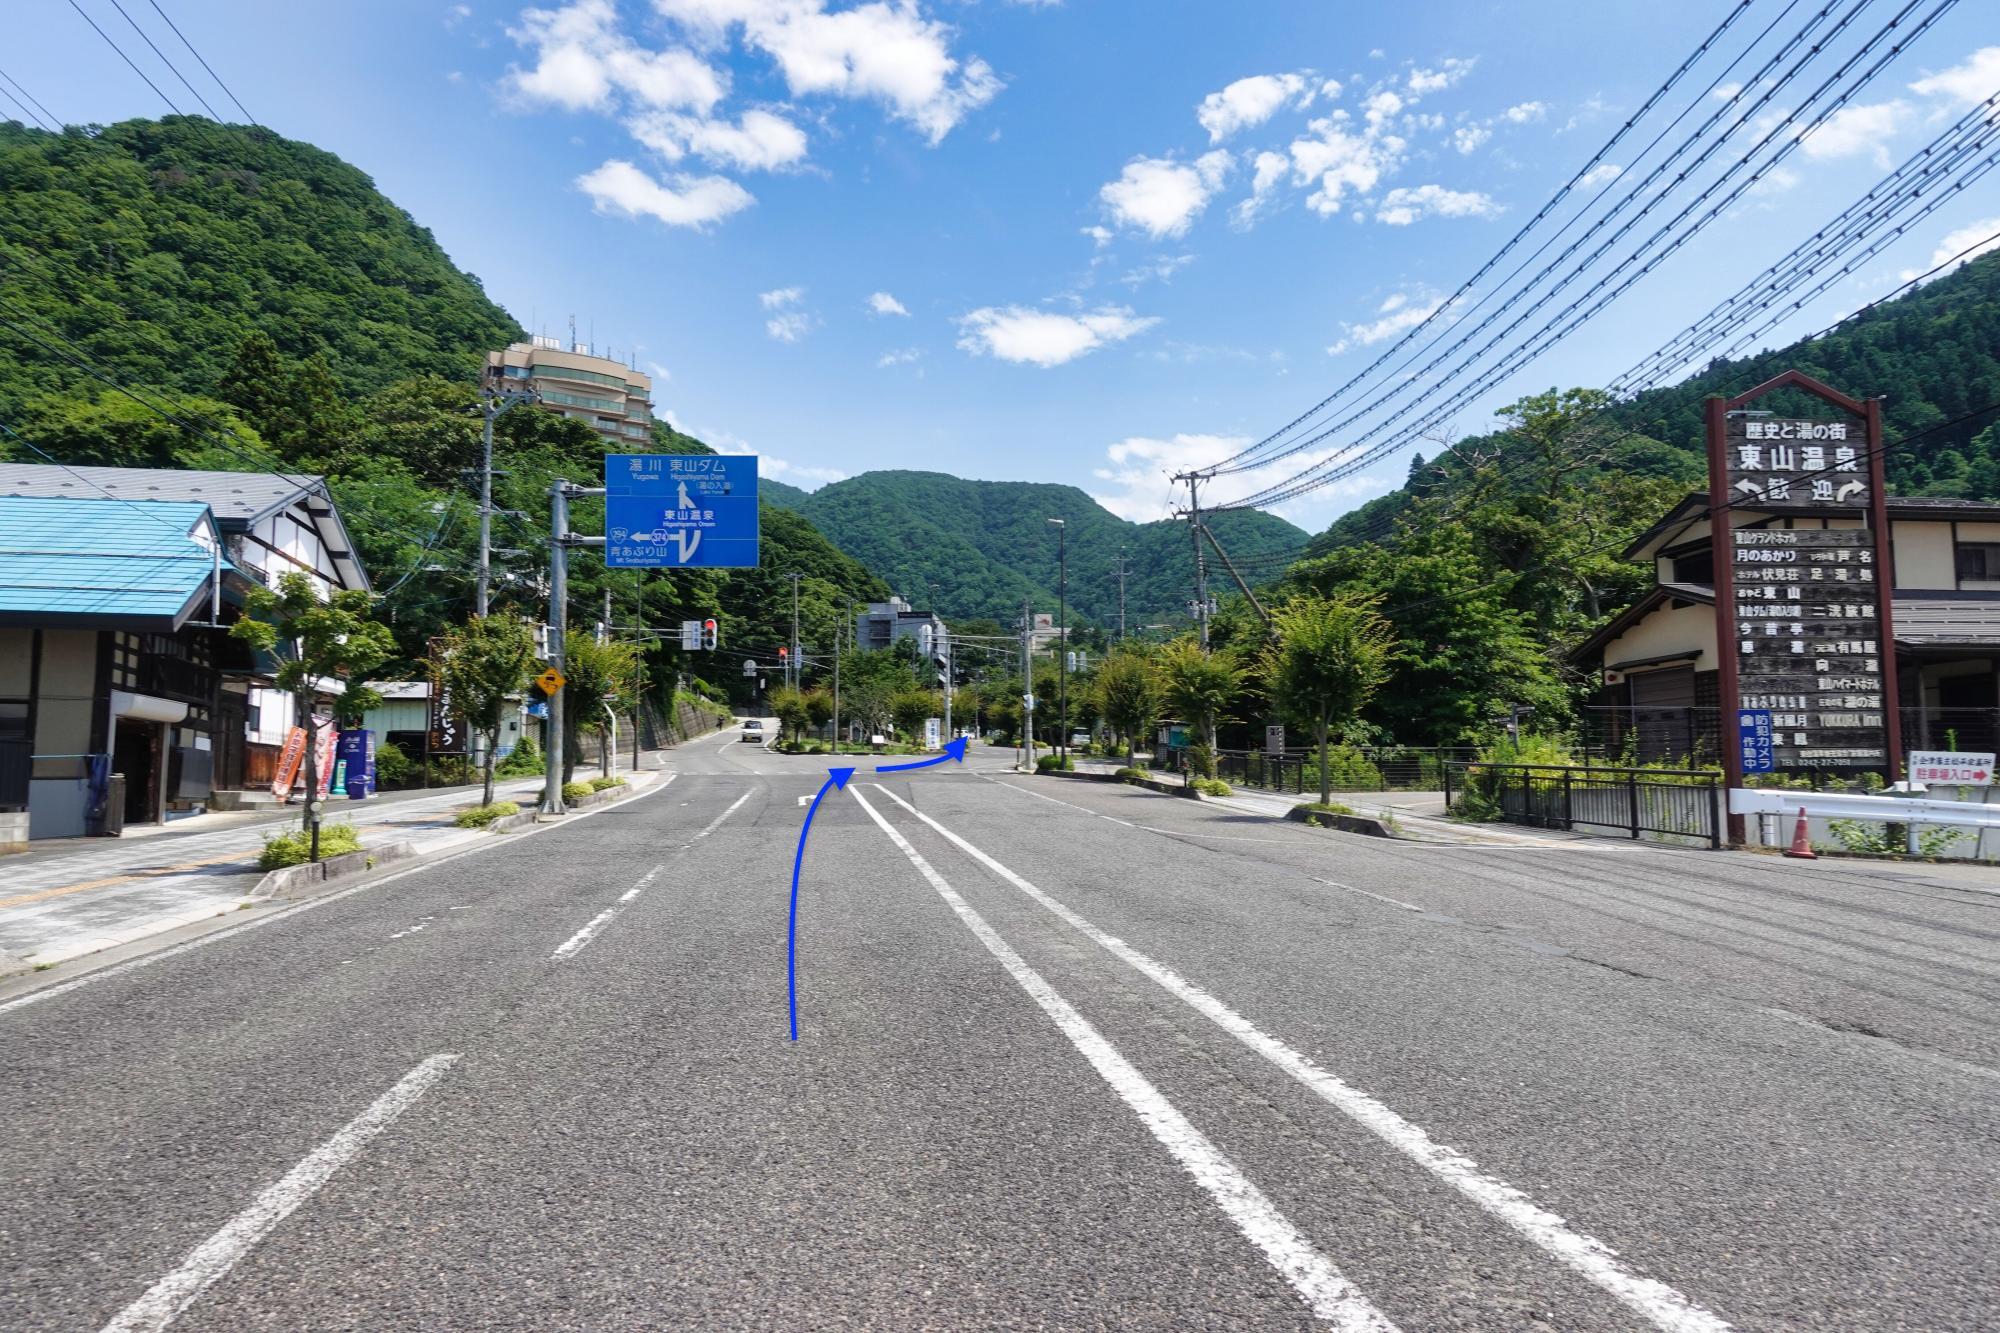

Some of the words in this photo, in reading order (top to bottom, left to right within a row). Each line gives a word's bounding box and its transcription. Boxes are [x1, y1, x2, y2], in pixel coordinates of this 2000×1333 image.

[1745, 422, 1847, 440] 歴史と湯の街
[629, 458, 662, 472] 湯川
[669, 458, 726, 472] 東山ダム
[1737, 445, 1859, 472] 東山温泉
[1767, 477, 1835, 501] 歓迎
[664, 510, 715, 521] 東山温泉
[653, 533, 667, 541] 374
[1736, 549, 1796, 562] 月のあかり
[1739, 622, 1804, 636] 今昔亭
[1755, 714, 1770, 769] 防犯カメラ
[1743, 736, 1757, 769] 作動中
[1916, 767, 1972, 781] 駐車場入口
